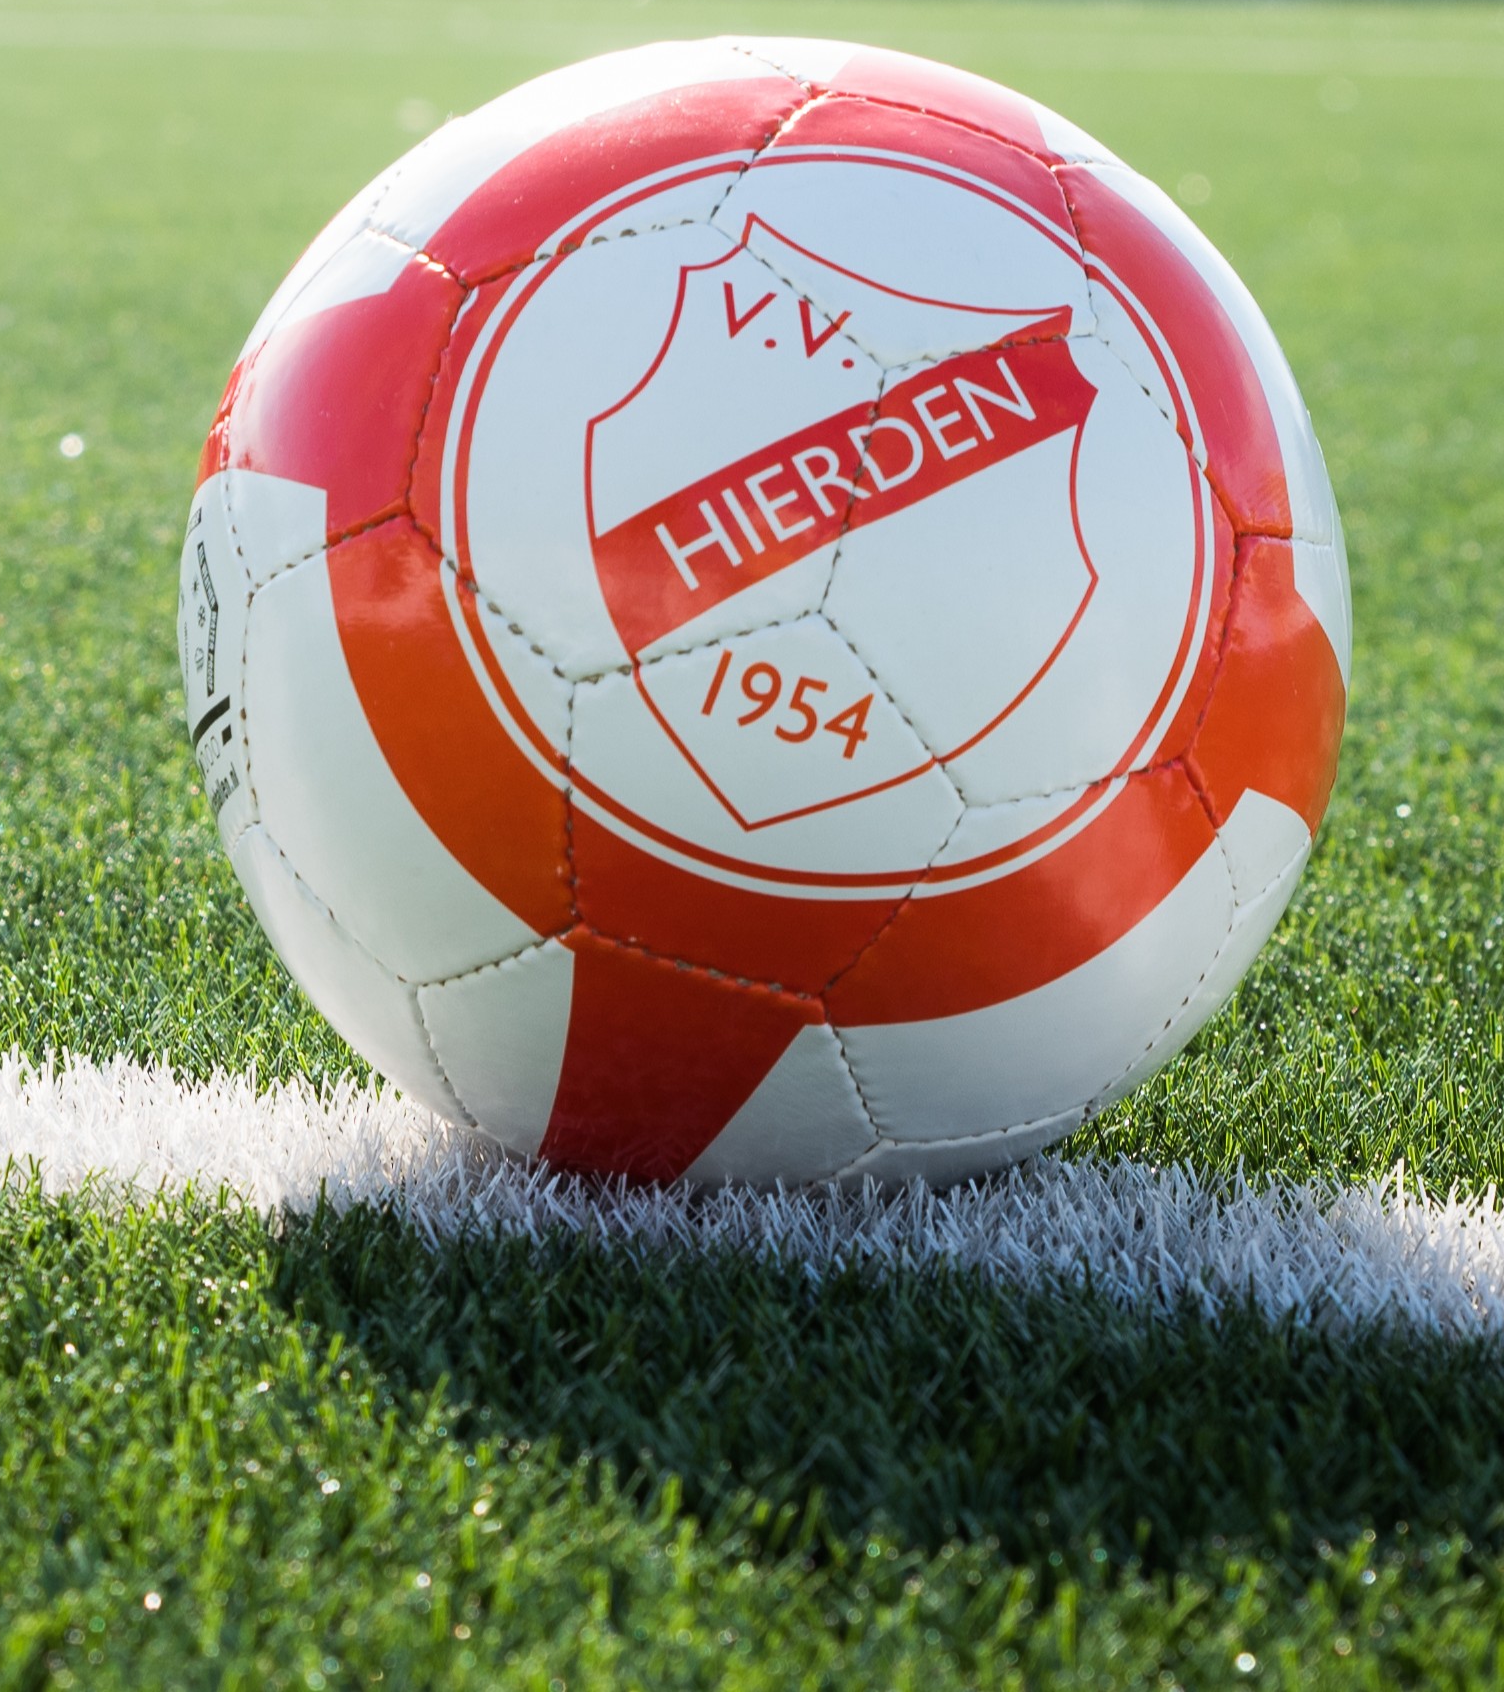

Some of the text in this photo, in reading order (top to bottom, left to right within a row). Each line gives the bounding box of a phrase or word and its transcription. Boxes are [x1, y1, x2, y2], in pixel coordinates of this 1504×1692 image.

[723, 281, 856, 369] V.V.
[654, 357, 1036, 592] HIERDEN
[700, 648, 876, 759] 1954
